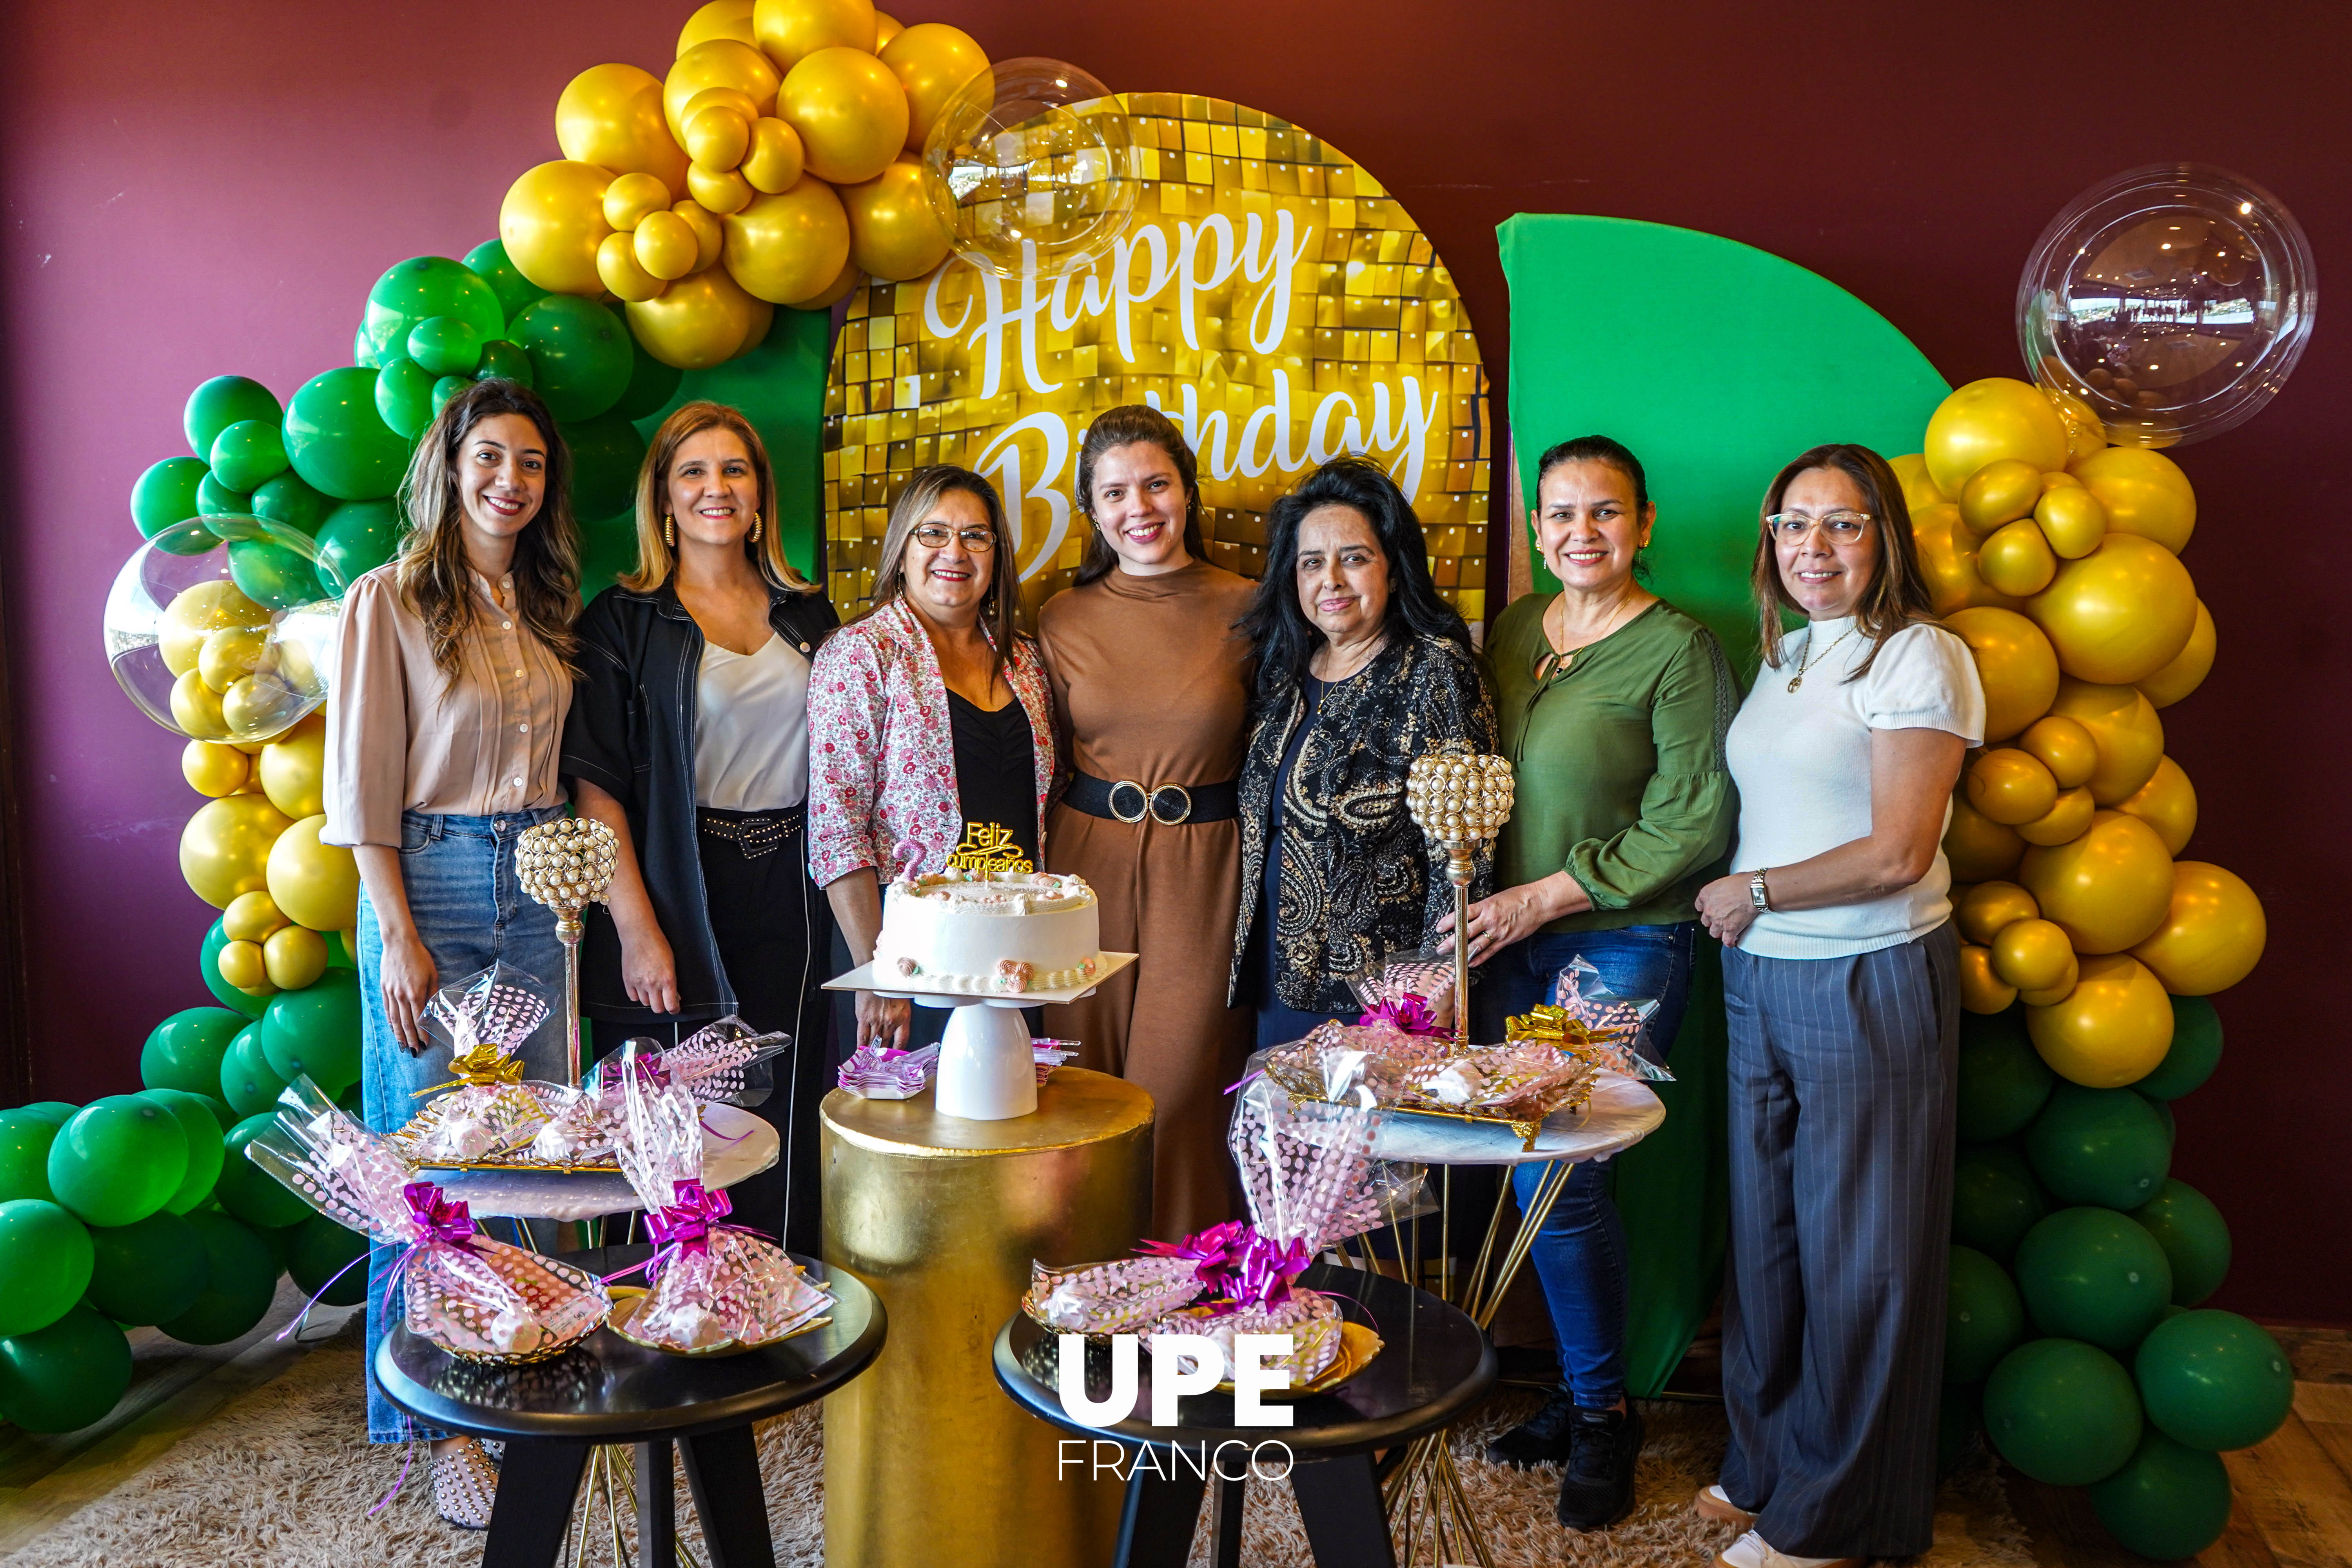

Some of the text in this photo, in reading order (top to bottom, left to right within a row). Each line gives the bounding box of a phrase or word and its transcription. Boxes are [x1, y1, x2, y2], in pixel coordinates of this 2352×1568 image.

[924, 210, 1312, 399] Happy
[967, 822, 1013, 847] Feliz
[946, 853, 1033, 875] cumpleaños
